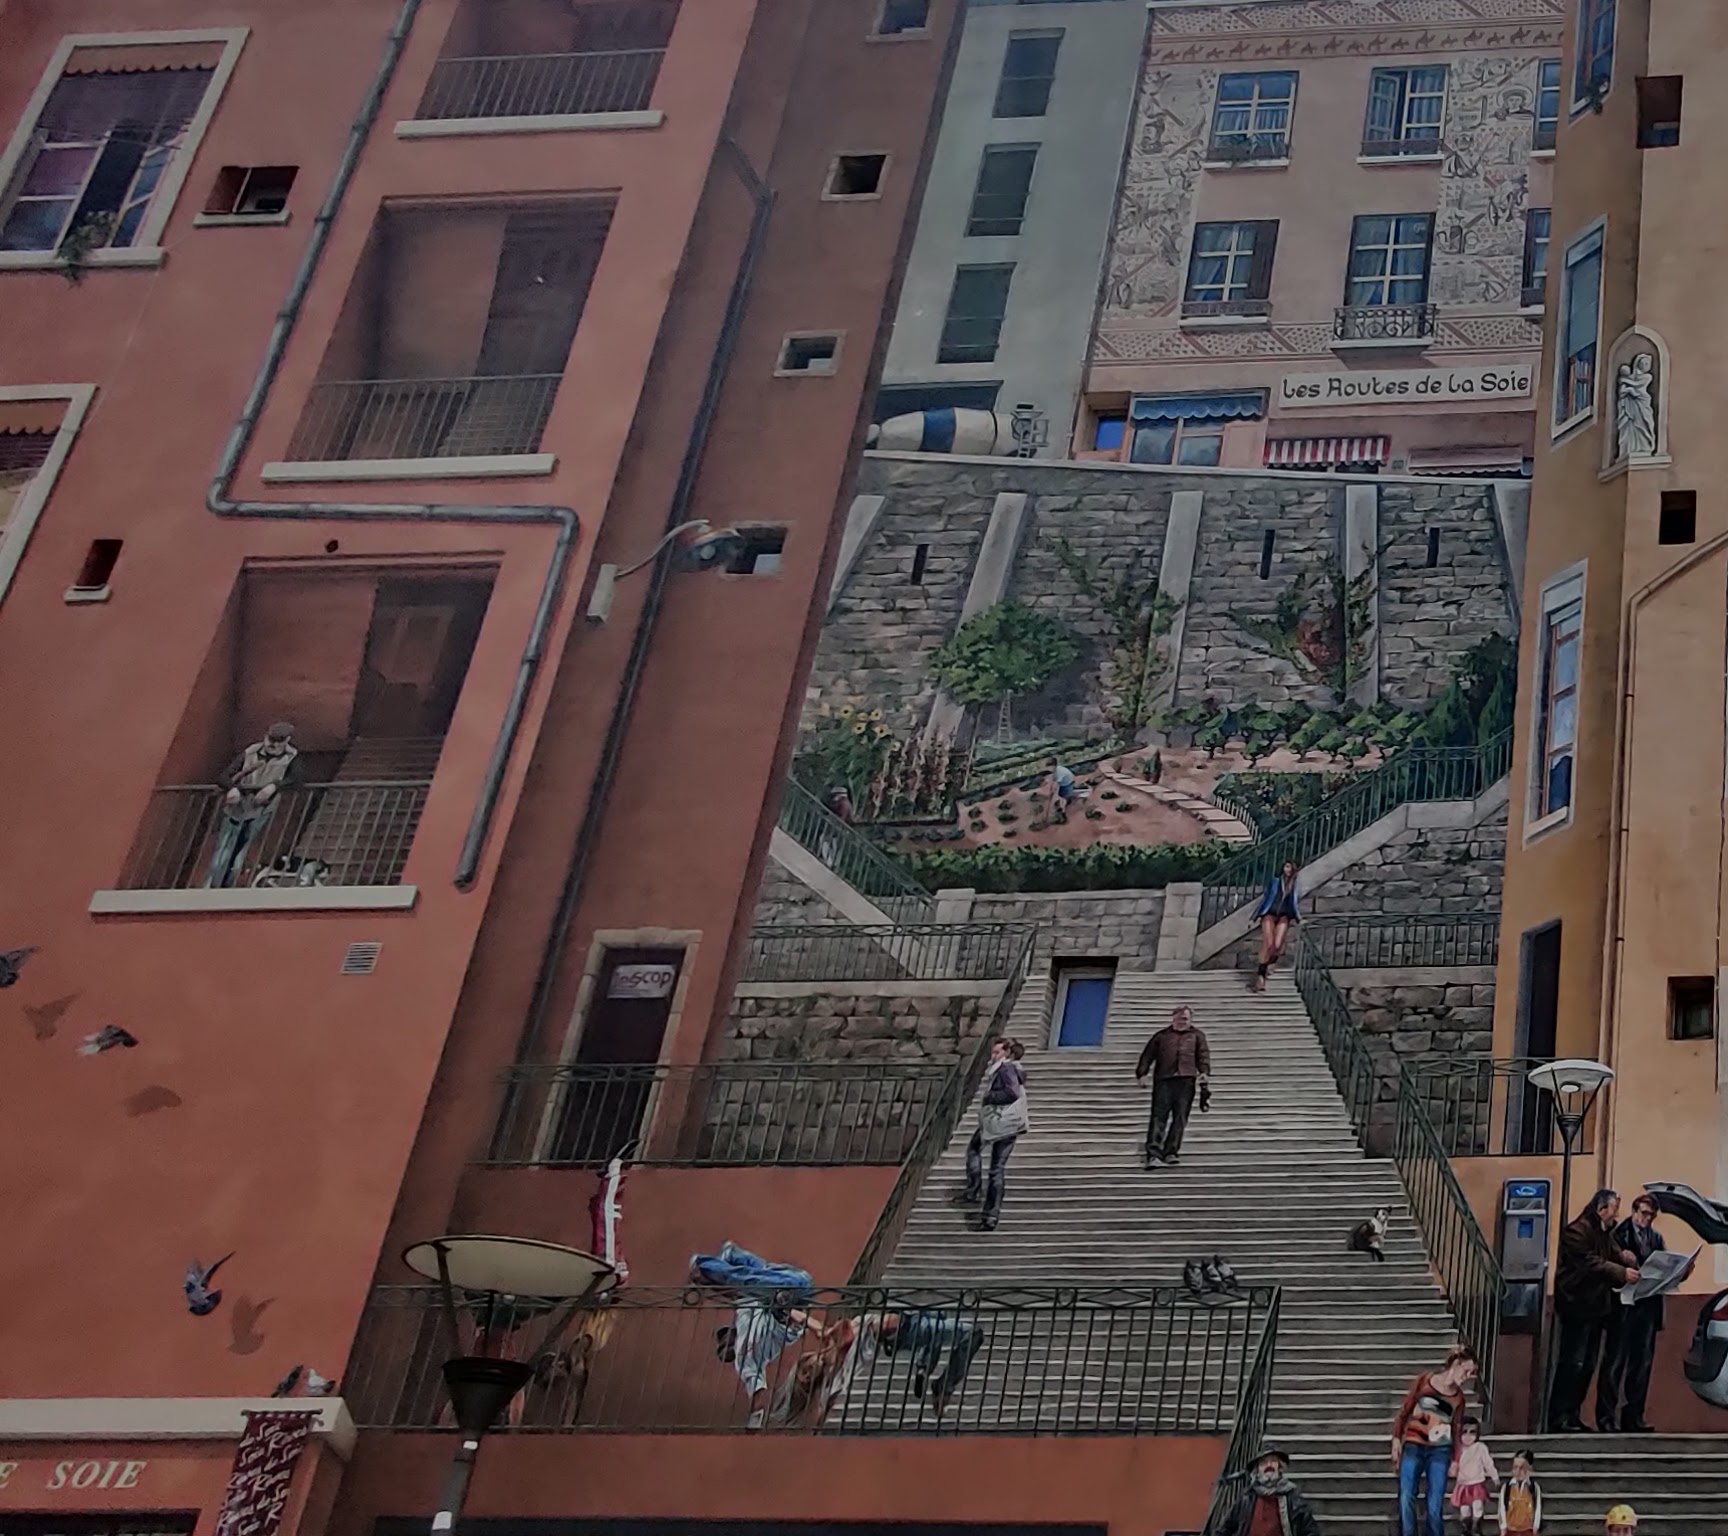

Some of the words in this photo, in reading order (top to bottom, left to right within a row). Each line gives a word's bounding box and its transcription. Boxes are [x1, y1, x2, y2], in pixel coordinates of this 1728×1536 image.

[1282, 378, 1320, 399] Les
[1326, 376, 1409, 398] Routes
[1415, 375, 1441, 395] de
[1448, 373, 1474, 394] La
[1480, 370, 1529, 393] Soie
[46, 1460, 148, 1490] SOIE
